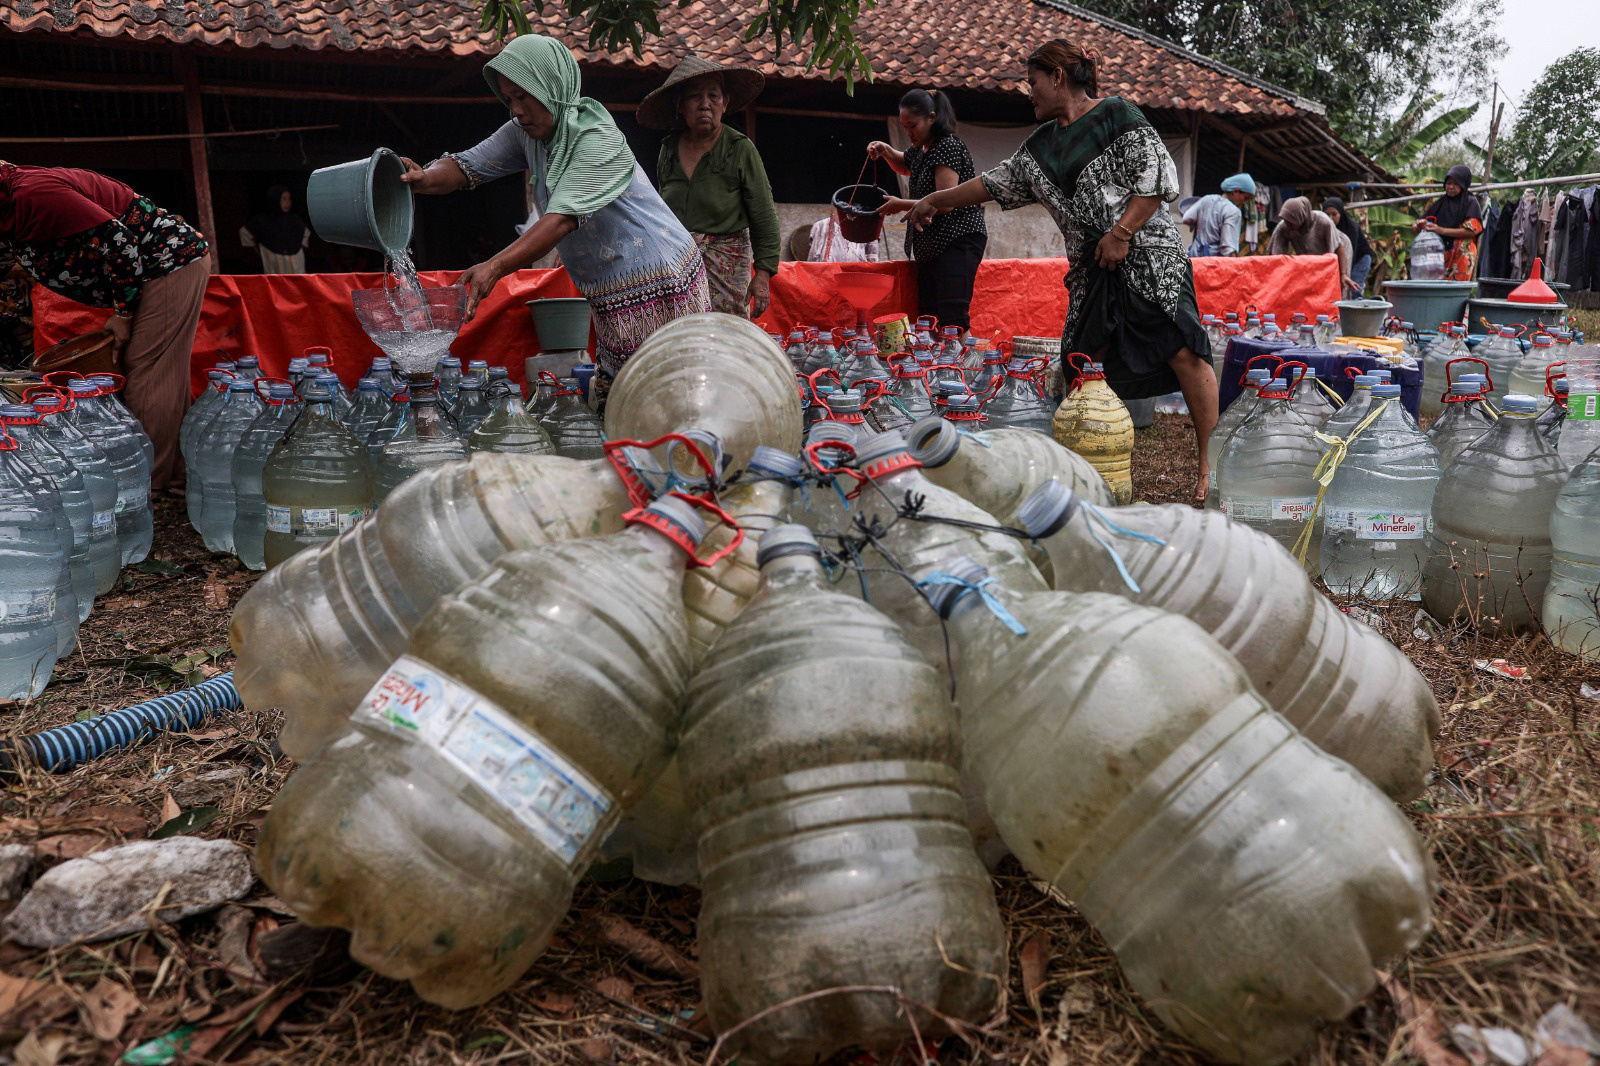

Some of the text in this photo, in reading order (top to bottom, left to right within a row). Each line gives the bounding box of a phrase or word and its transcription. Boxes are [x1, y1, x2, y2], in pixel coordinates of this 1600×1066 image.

[1292, 512, 1303, 522] Le
[1392, 514, 1405, 525] Le
[1372, 522, 1416, 532] Minerale
